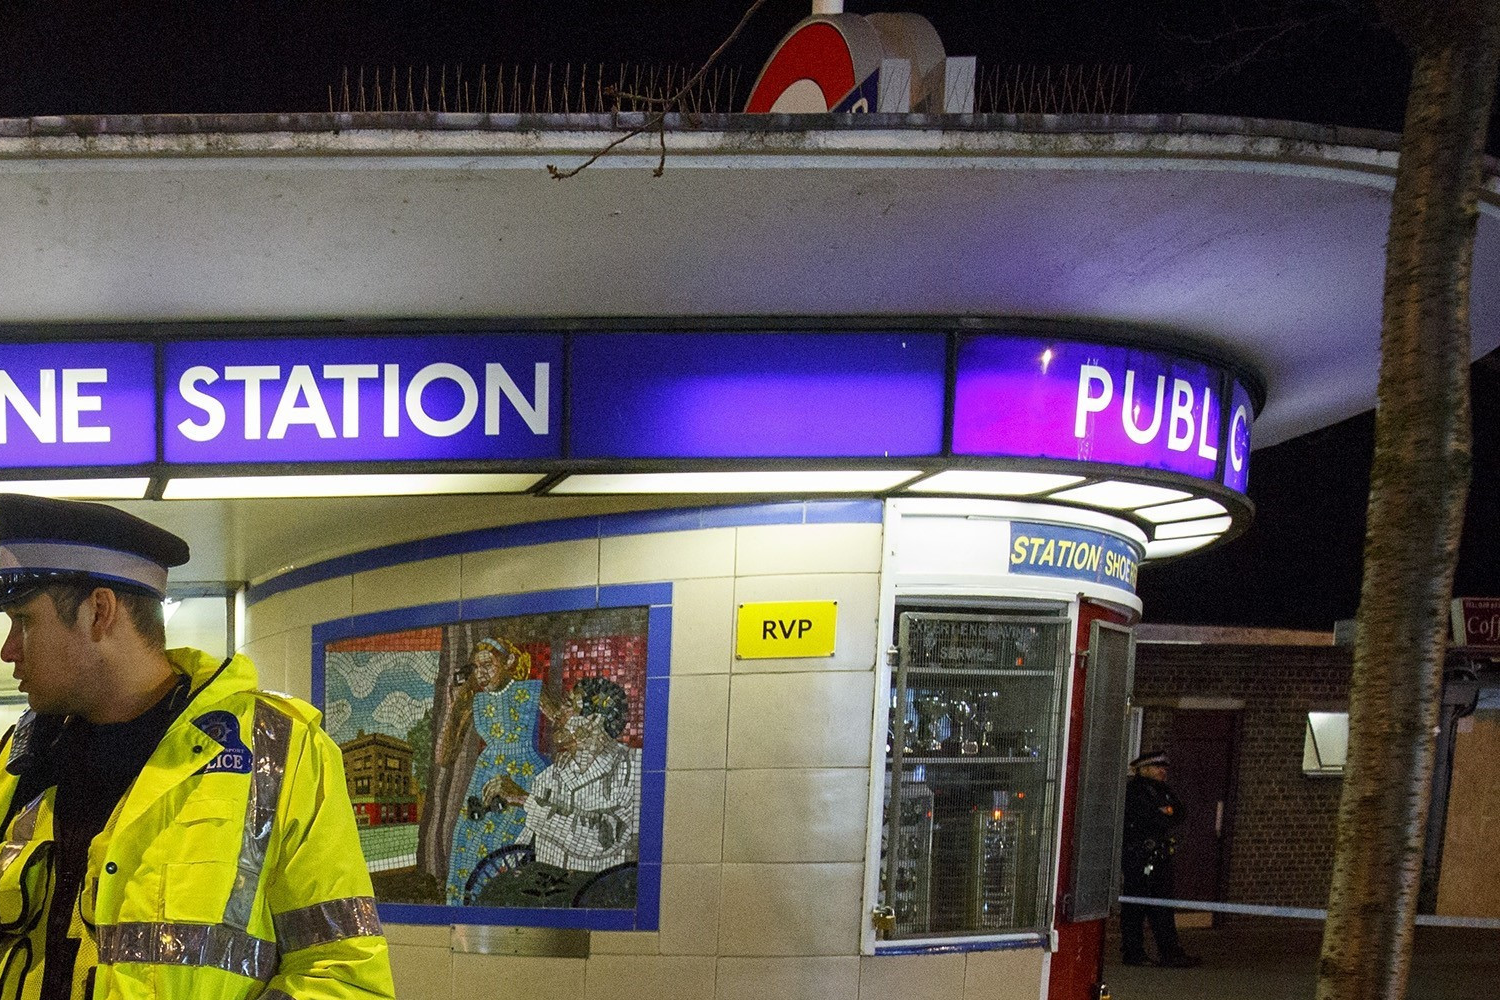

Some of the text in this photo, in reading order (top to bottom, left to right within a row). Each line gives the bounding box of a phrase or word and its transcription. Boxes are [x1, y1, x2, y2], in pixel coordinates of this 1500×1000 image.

[176, 361, 549, 442] STATION
[1010, 535, 1103, 572] STATION
[762, 619, 813, 640] RVP
[206, 754, 243, 769] LICE
